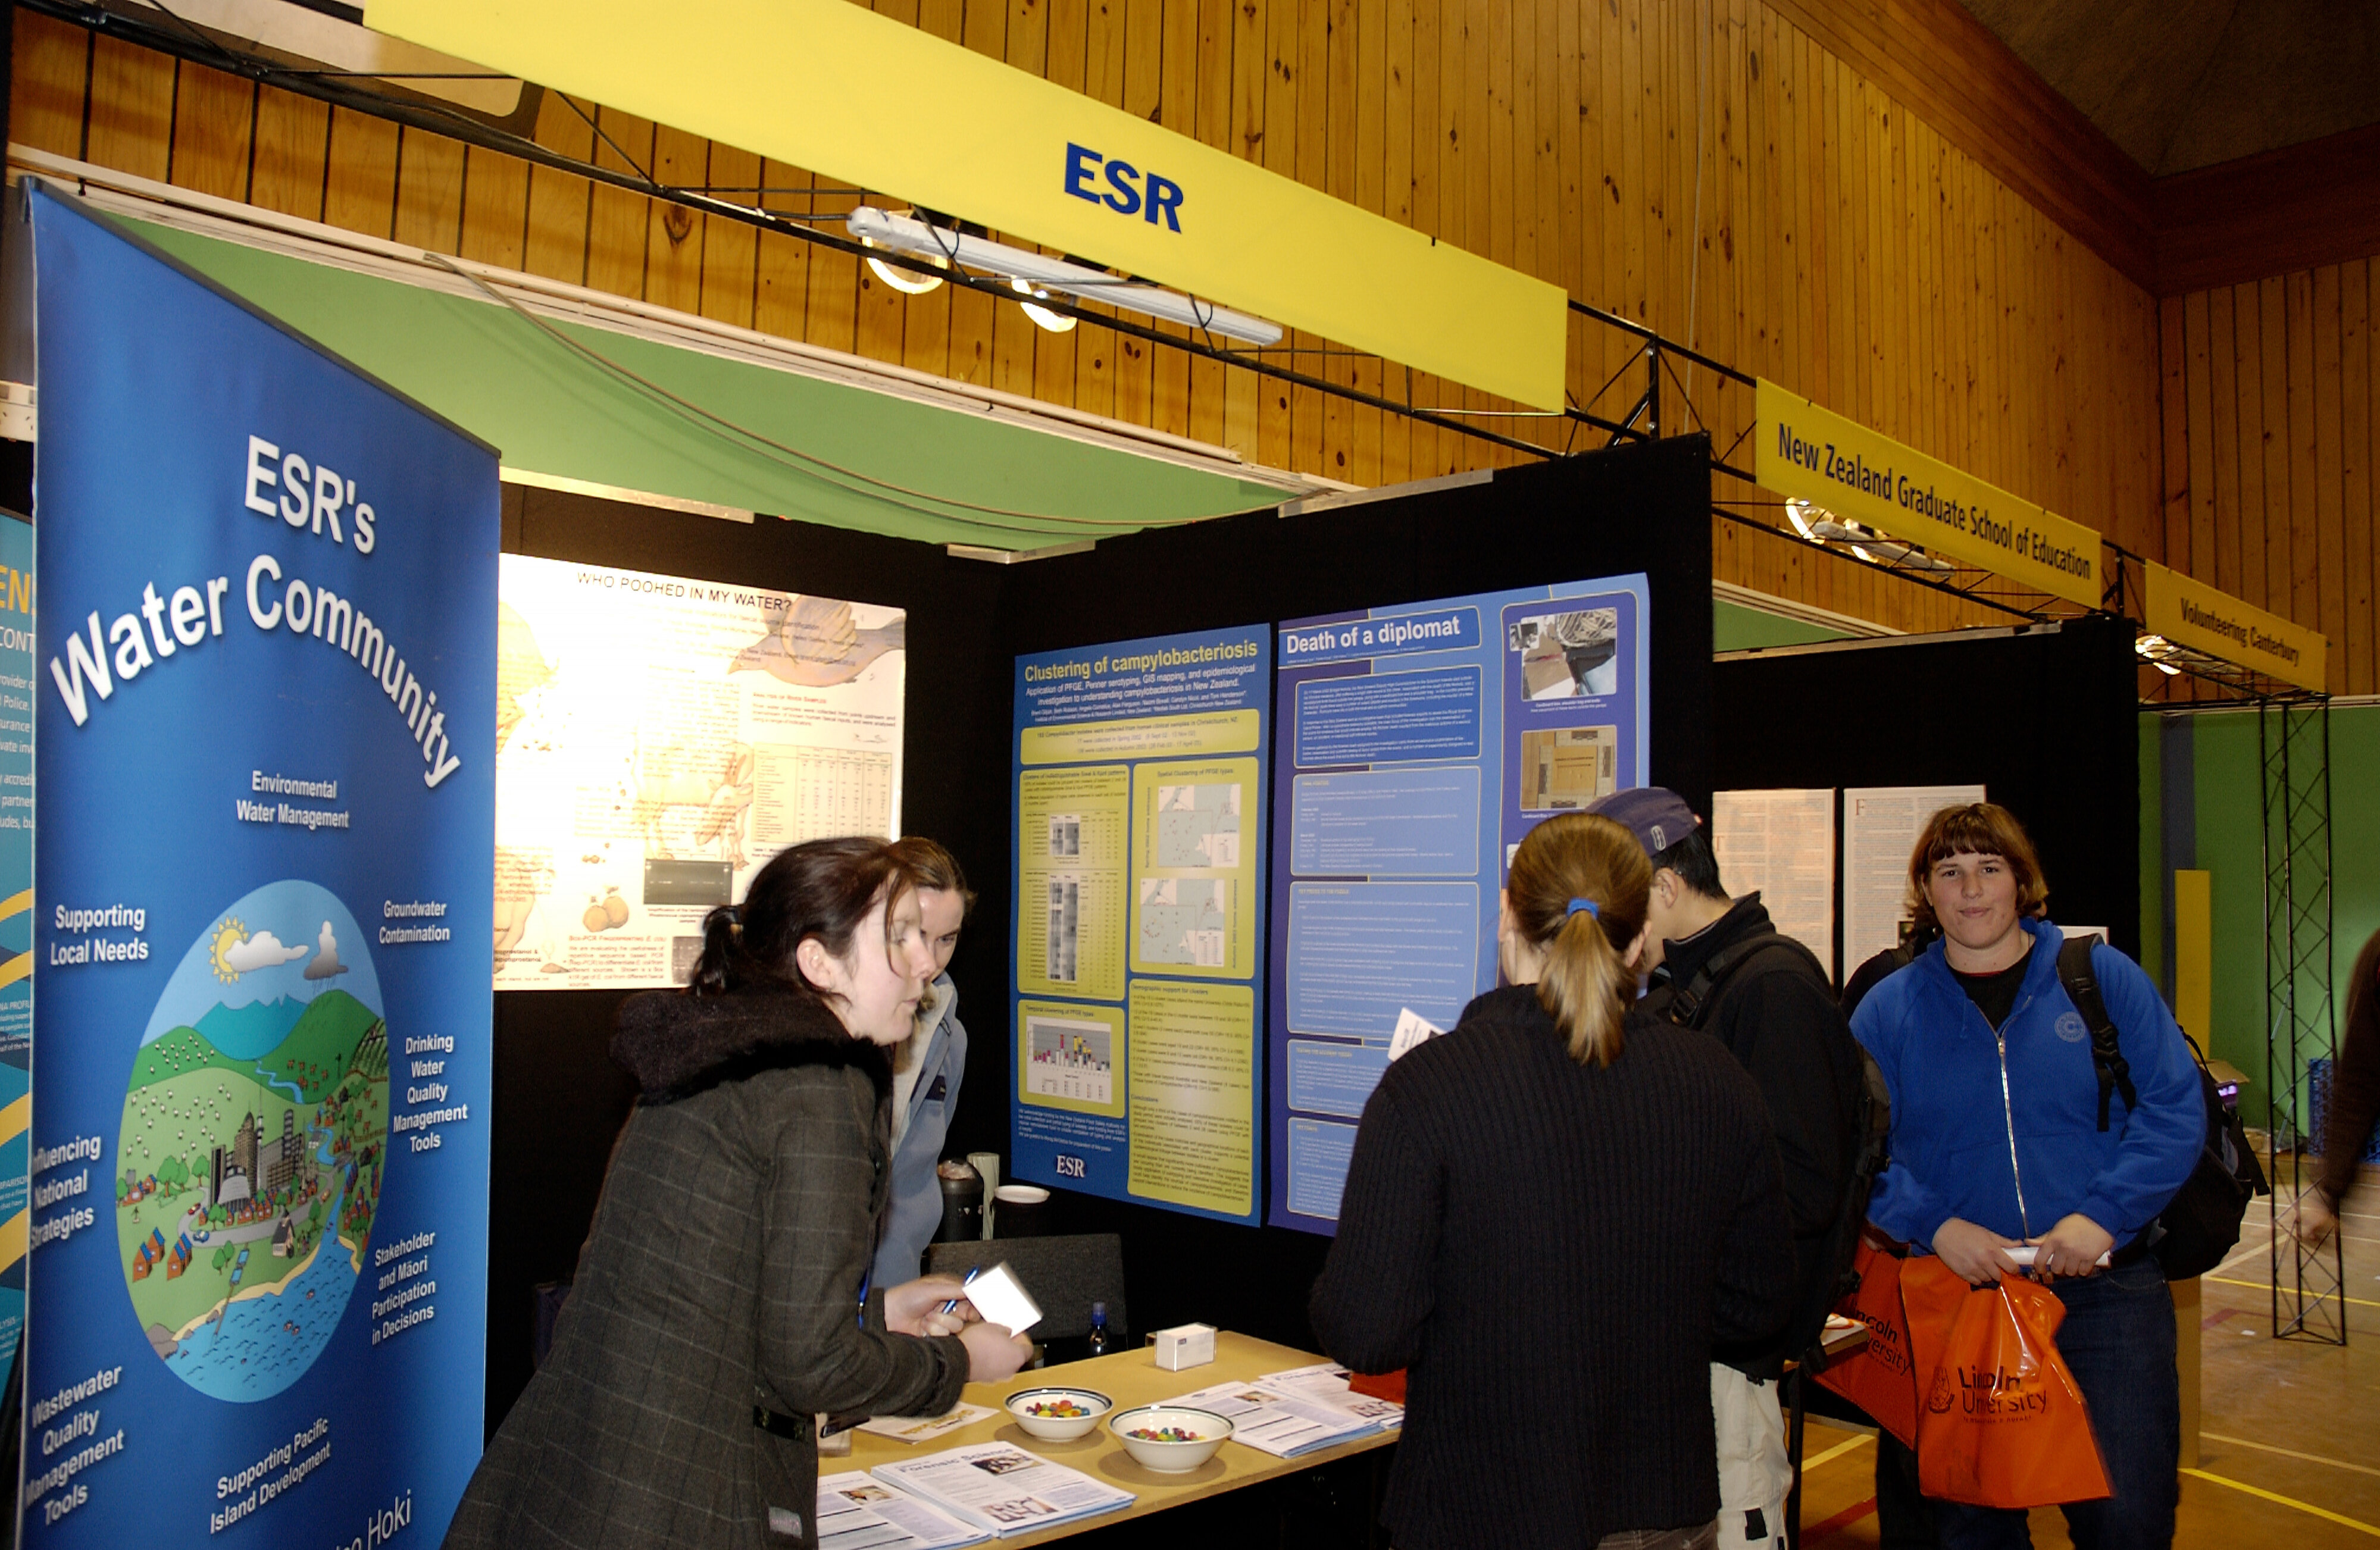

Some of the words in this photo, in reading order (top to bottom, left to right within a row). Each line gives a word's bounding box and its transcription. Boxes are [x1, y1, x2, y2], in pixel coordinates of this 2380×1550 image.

[1064, 141, 1182, 234] ESR
[245, 434, 376, 554] ESR's
[1778, 422, 1819, 471] New
[1825, 443, 1892, 502] Zealand
[1898, 475, 1965, 531] Graduate
[1970, 506, 2012, 550] School
[2016, 527, 2029, 556] of
[2032, 533, 2090, 580] Education
[578, 572, 615, 588] WHO
[621, 577, 685, 597] POOHED
[690, 586, 704, 600] IN
[709, 588, 730, 603] MY
[733, 592, 792, 612] WATER?
[0, 627, 35, 653] ONT
[1287, 631, 1336, 654] Death
[1340, 626, 1358, 647] of
[1363, 630, 1373, 644] a
[1378, 615, 1460, 646] diplomat
[2181, 597, 2247, 648] Volunteering
[2250, 626, 2300, 667] Canterbury
[50, 576, 229, 727] Water
[247, 554, 461, 788] Community
[1025, 660, 1091, 682] Clustering
[1094, 656, 1108, 674] of
[1112, 639, 1258, 673] campylobacteriosis
[1026, 686, 1056, 697] Application
[1058, 684, 1064, 693] of
[1143, 674, 1155, 684] GIS
[1189, 669, 1201, 679] and
[1202, 663, 1256, 678] epidemiological
[1081, 690, 1123, 702] understanding
[1193, 681, 1208, 691] New
[252, 770, 337, 799] Environmental
[236, 799, 275, 822] Water
[278, 803, 349, 831] Management
[55, 903, 146, 934] Supporting
[384, 899, 446, 919] Groundwater
[51, 938, 89, 966] Local
[94, 936, 149, 962] Needs
[379, 926, 451, 944] Contamination
[405, 1034, 454, 1055] Drinking
[411, 1060, 445, 1078] Water
[407, 1082, 448, 1104] Quality
[393, 1103, 468, 1133] Management
[32, 1135, 101, 1176] nfluencing
[409, 1131, 441, 1153] Tools
[1056, 1154, 1085, 1178] ESR
[35, 1167, 88, 1211] National
[30, 1206, 95, 1250] Strategies
[374, 1231, 436, 1267] Stakeholder
[379, 1267, 396, 1291] and
[398, 1254, 428, 1281] Māori
[372, 1280, 436, 1320] Participation
[372, 1327, 380, 1345] in
[383, 1305, 434, 1339] Decisions
[1856, 1308, 1898, 1344] ncoln
[32, 1365, 123, 1428] Wastewater
[42, 1409, 100, 1455] Quality
[26, 1429, 125, 1509] Management
[217, 1443, 291, 1499] Supporting
[293, 1417, 329, 1454] Pacific
[44, 1484, 88, 1526] Tools
[209, 1490, 256, 1535] Island
[259, 1441, 331, 1506] Development
[367, 1488, 411, 1550] Hoki
